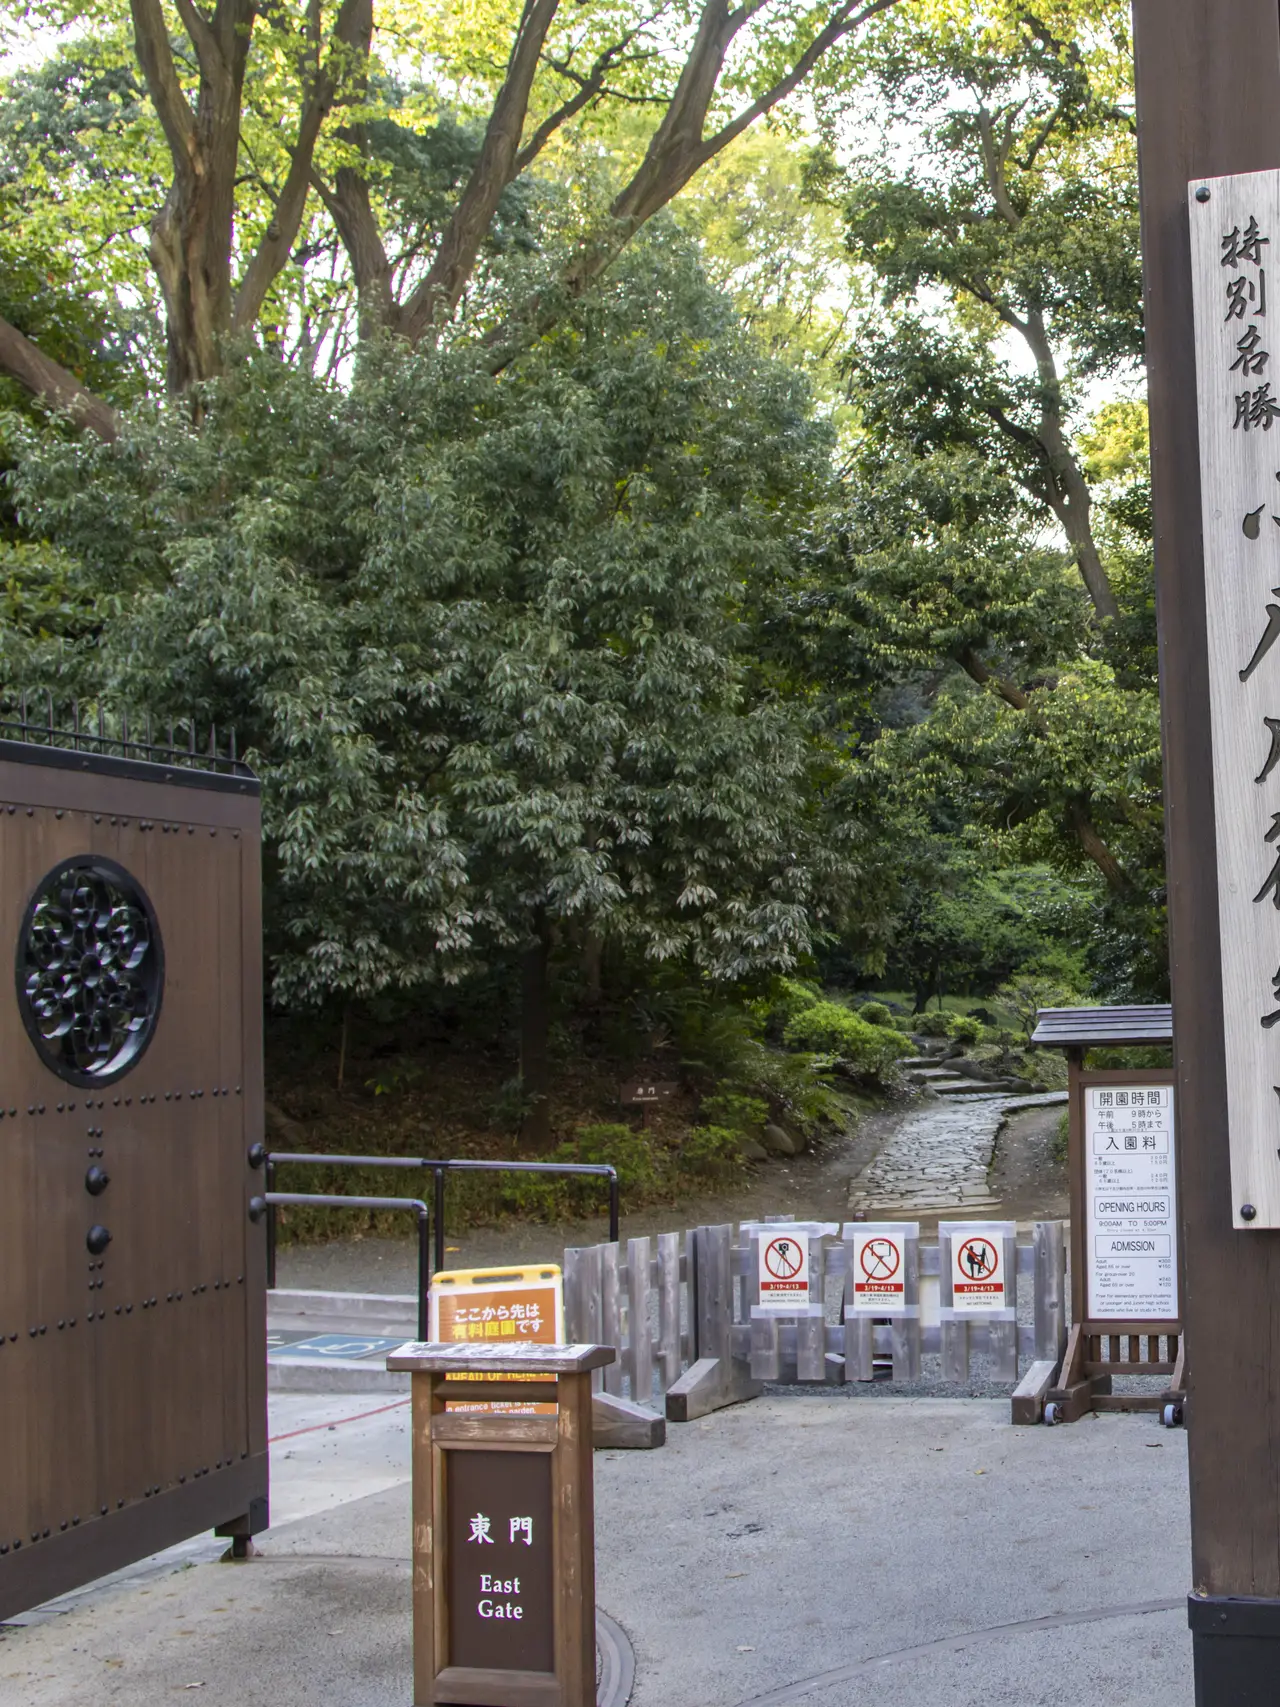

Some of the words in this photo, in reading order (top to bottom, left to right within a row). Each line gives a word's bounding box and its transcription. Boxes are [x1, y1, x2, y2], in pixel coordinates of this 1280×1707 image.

[1099, 1091, 1160, 1106] 開園時間
[1098, 1110, 1114, 1119] 午前
[1098, 1121, 1114, 1129] 午後
[1106, 1135, 1156, 1150] 入園料
[1098, 1202, 1134, 1212] OPENING
[1137, 1202, 1165, 1212] HOURS
[1111, 1240, 1155, 1251] ADMISSION
[455, 1302, 540, 1323] ここから先は
[455, 1402, 489, 1413] entrance
[467, 1512, 533, 1546] 東門
[480, 1574, 521, 1594] East
[478, 1600, 523, 1619] Gate
